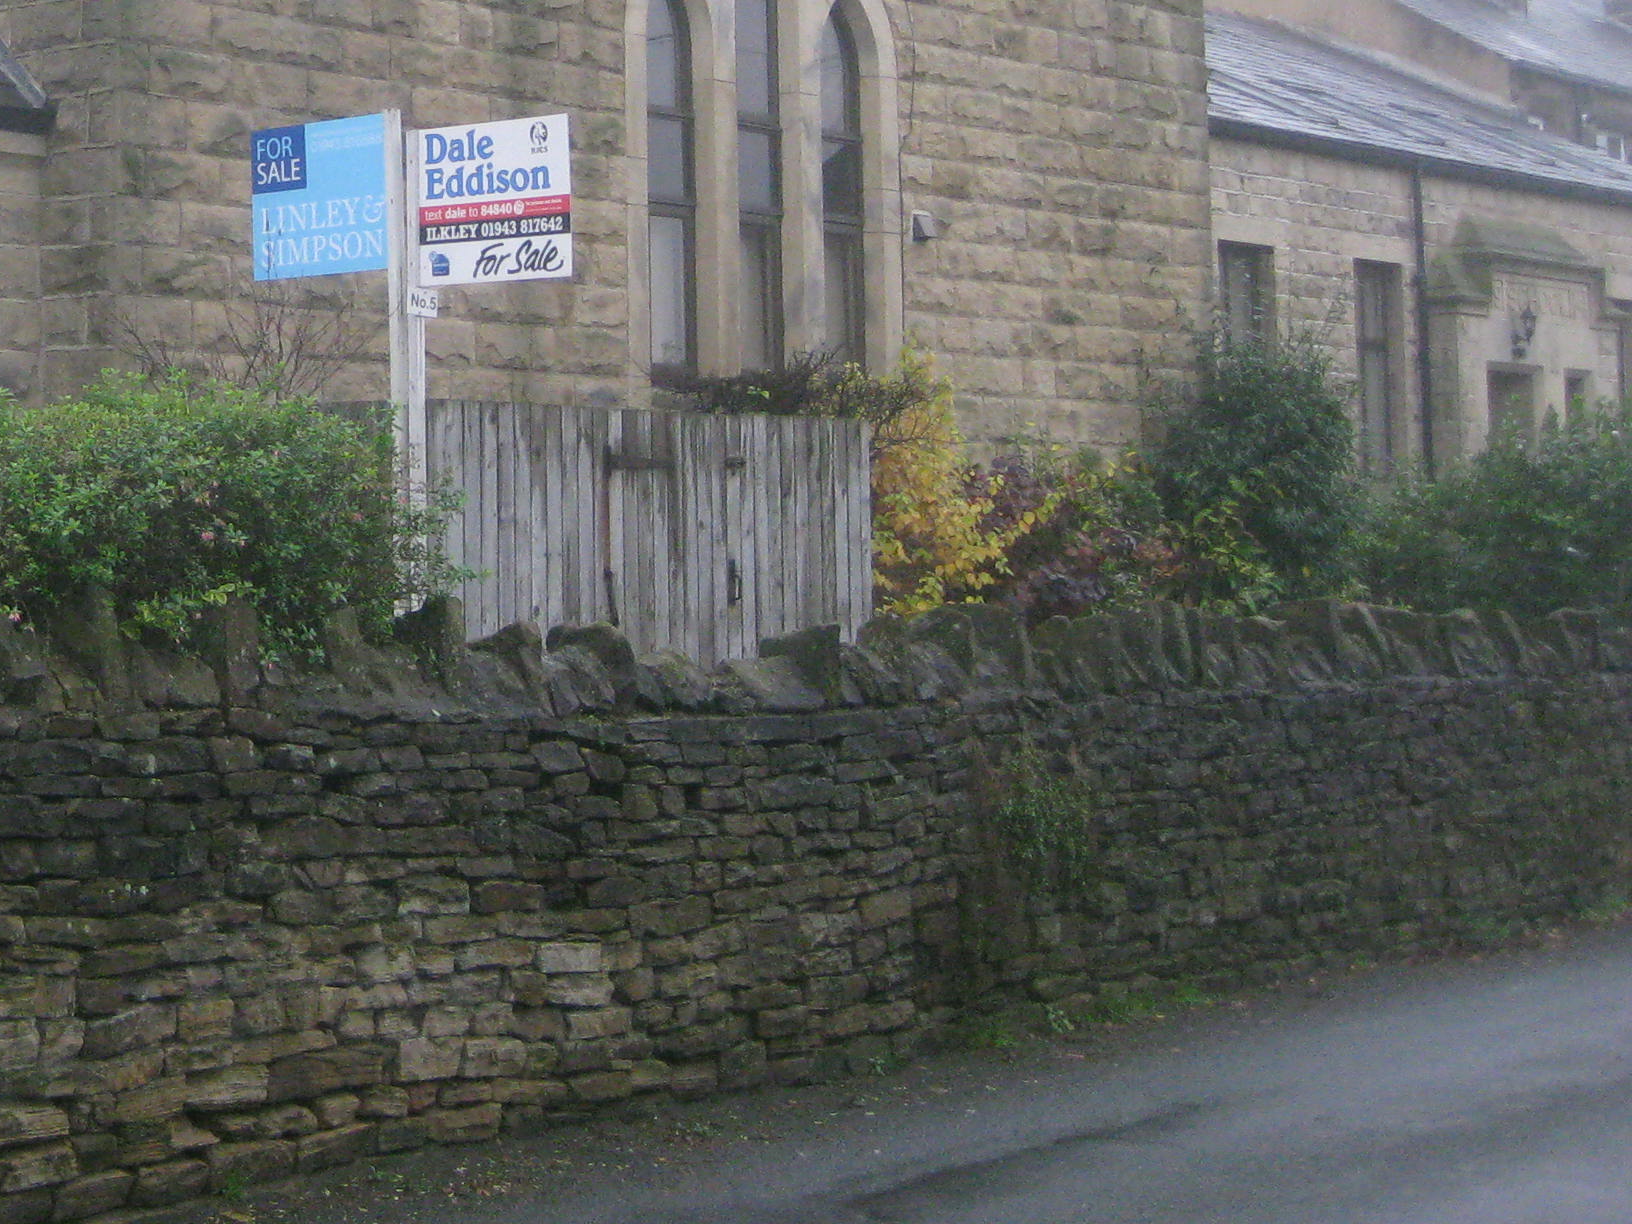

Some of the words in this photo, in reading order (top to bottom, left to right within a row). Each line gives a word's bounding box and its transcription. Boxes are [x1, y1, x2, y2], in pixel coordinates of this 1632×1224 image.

[256, 136, 293, 161] FOR
[424, 129, 495, 164] Dale
[257, 158, 301, 185] SALE
[425, 162, 551, 200] Eddison
[261, 197, 361, 234] LINLEY
[425, 209, 443, 221] text
[445, 207, 467, 220] dale
[469, 206, 479, 217] to
[480, 203, 513, 216] 84840
[425, 223, 479, 242] ILKLEY
[481, 220, 517, 237] 01943
[520, 215, 564, 234] 817642
[261, 228, 384, 268] SIMPSON
[472, 242, 511, 278] For
[507, 239, 564, 275] Sale
[410, 293, 437, 310] No.5
